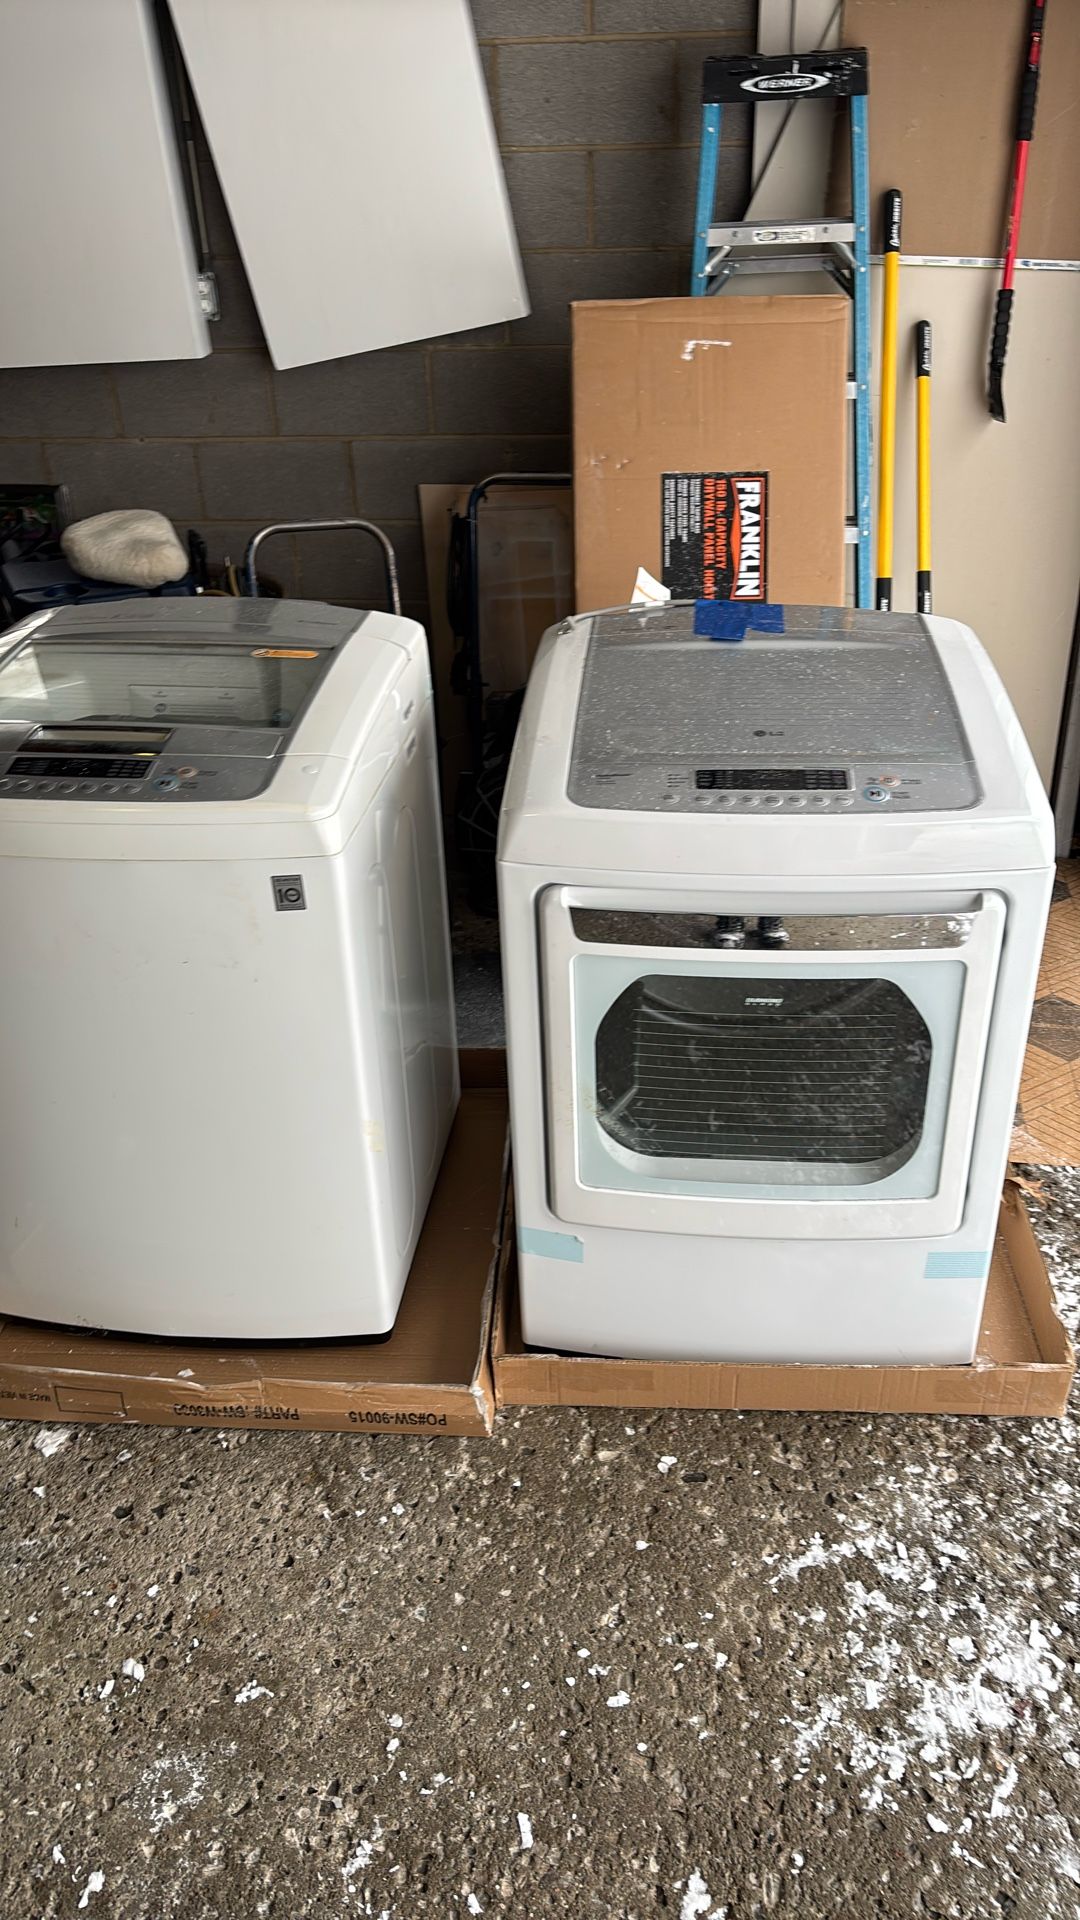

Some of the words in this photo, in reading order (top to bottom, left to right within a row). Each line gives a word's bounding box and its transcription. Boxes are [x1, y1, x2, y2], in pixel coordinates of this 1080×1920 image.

[757, 76, 814, 90] WERNER
[704, 479, 715, 530] DRYWALL
[715, 480, 727, 498] 150
[704, 532, 715, 566] PANEL
[715, 517, 727, 569] CAPACITY
[735, 481, 761, 596] FRANKLIN
[348, 1411, 447, 1426] PO#SW-90015
